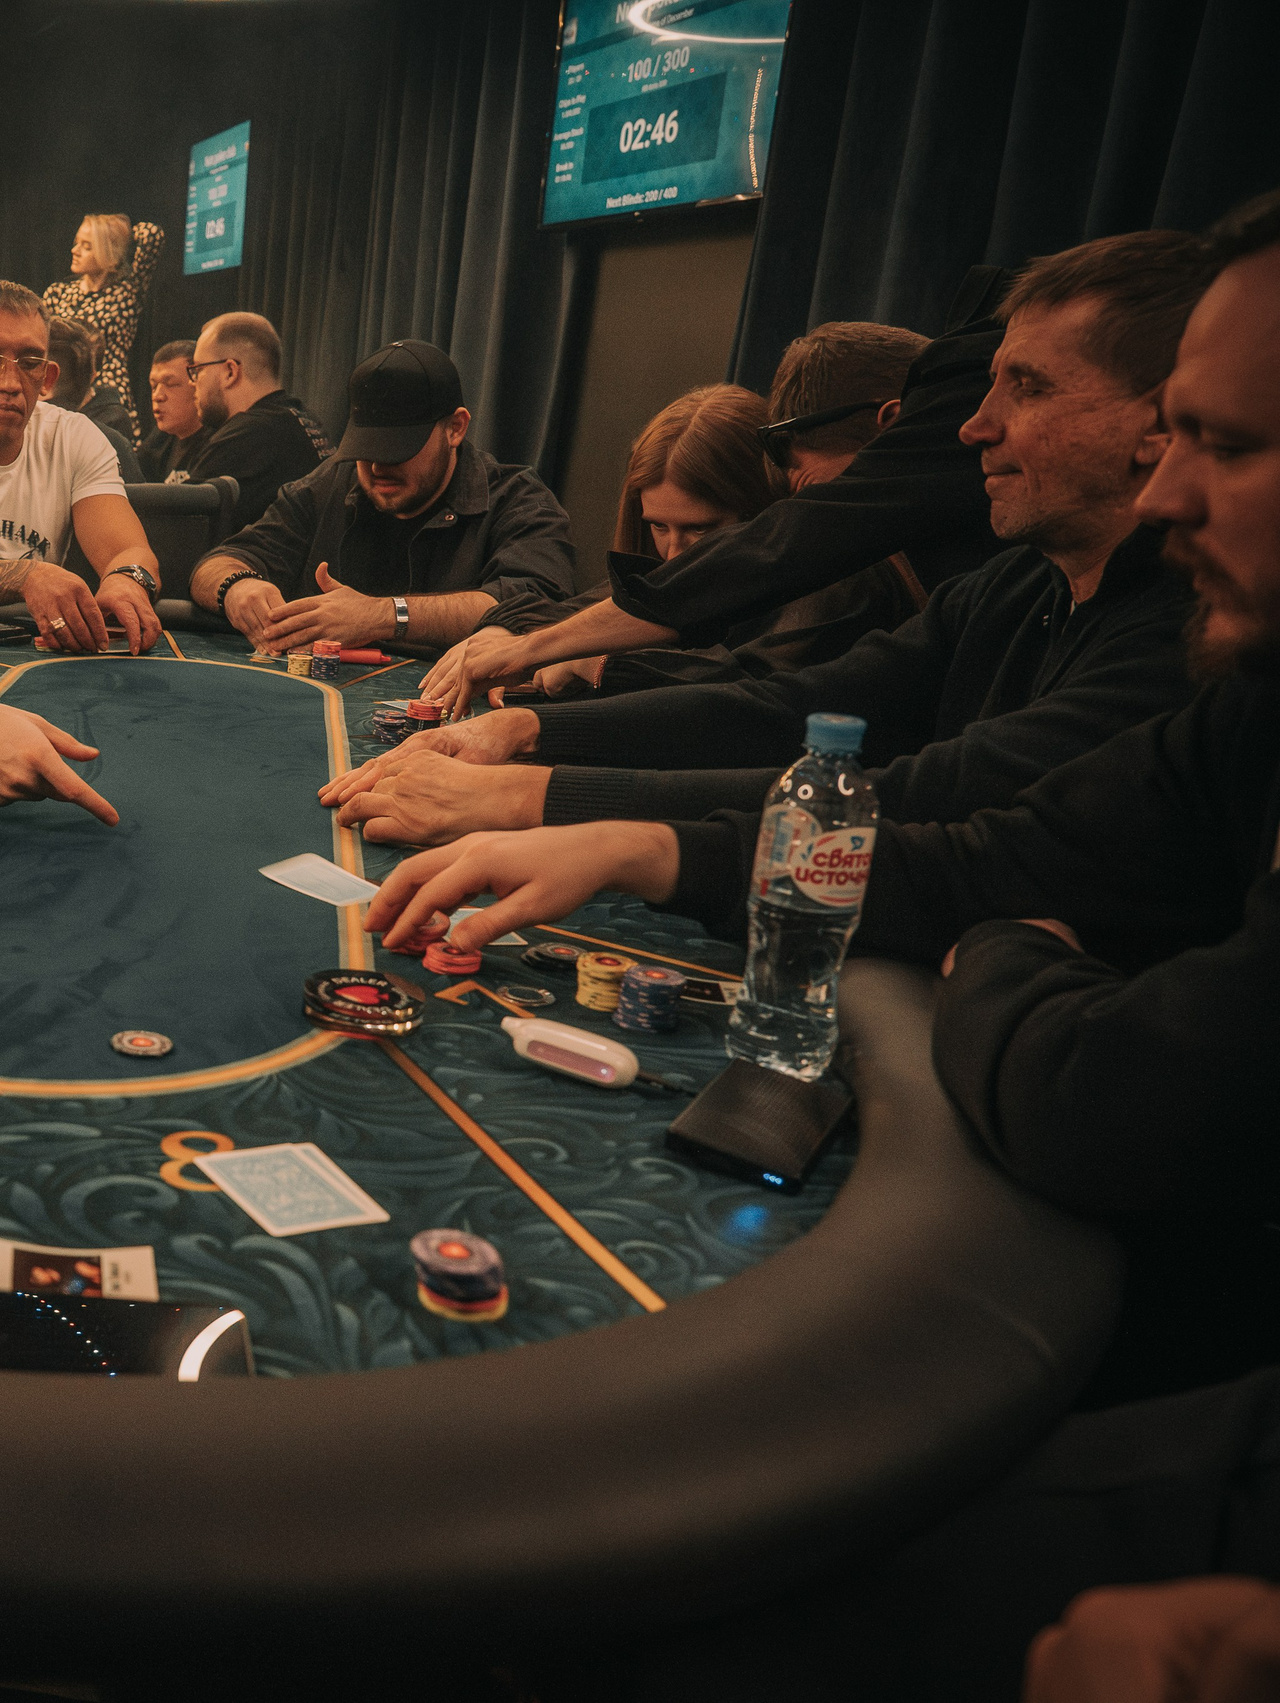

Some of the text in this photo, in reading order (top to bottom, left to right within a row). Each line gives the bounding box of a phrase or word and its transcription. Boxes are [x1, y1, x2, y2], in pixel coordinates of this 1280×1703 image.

[628, 46, 690, 83] 100 / 300
[619, 109, 679, 153] 02:46
[606, 196, 622, 209] Next
[644, 189, 659, 203] 200
[331, 976, 388, 988] DEALER
[159, 1130, 234, 1192] 8
